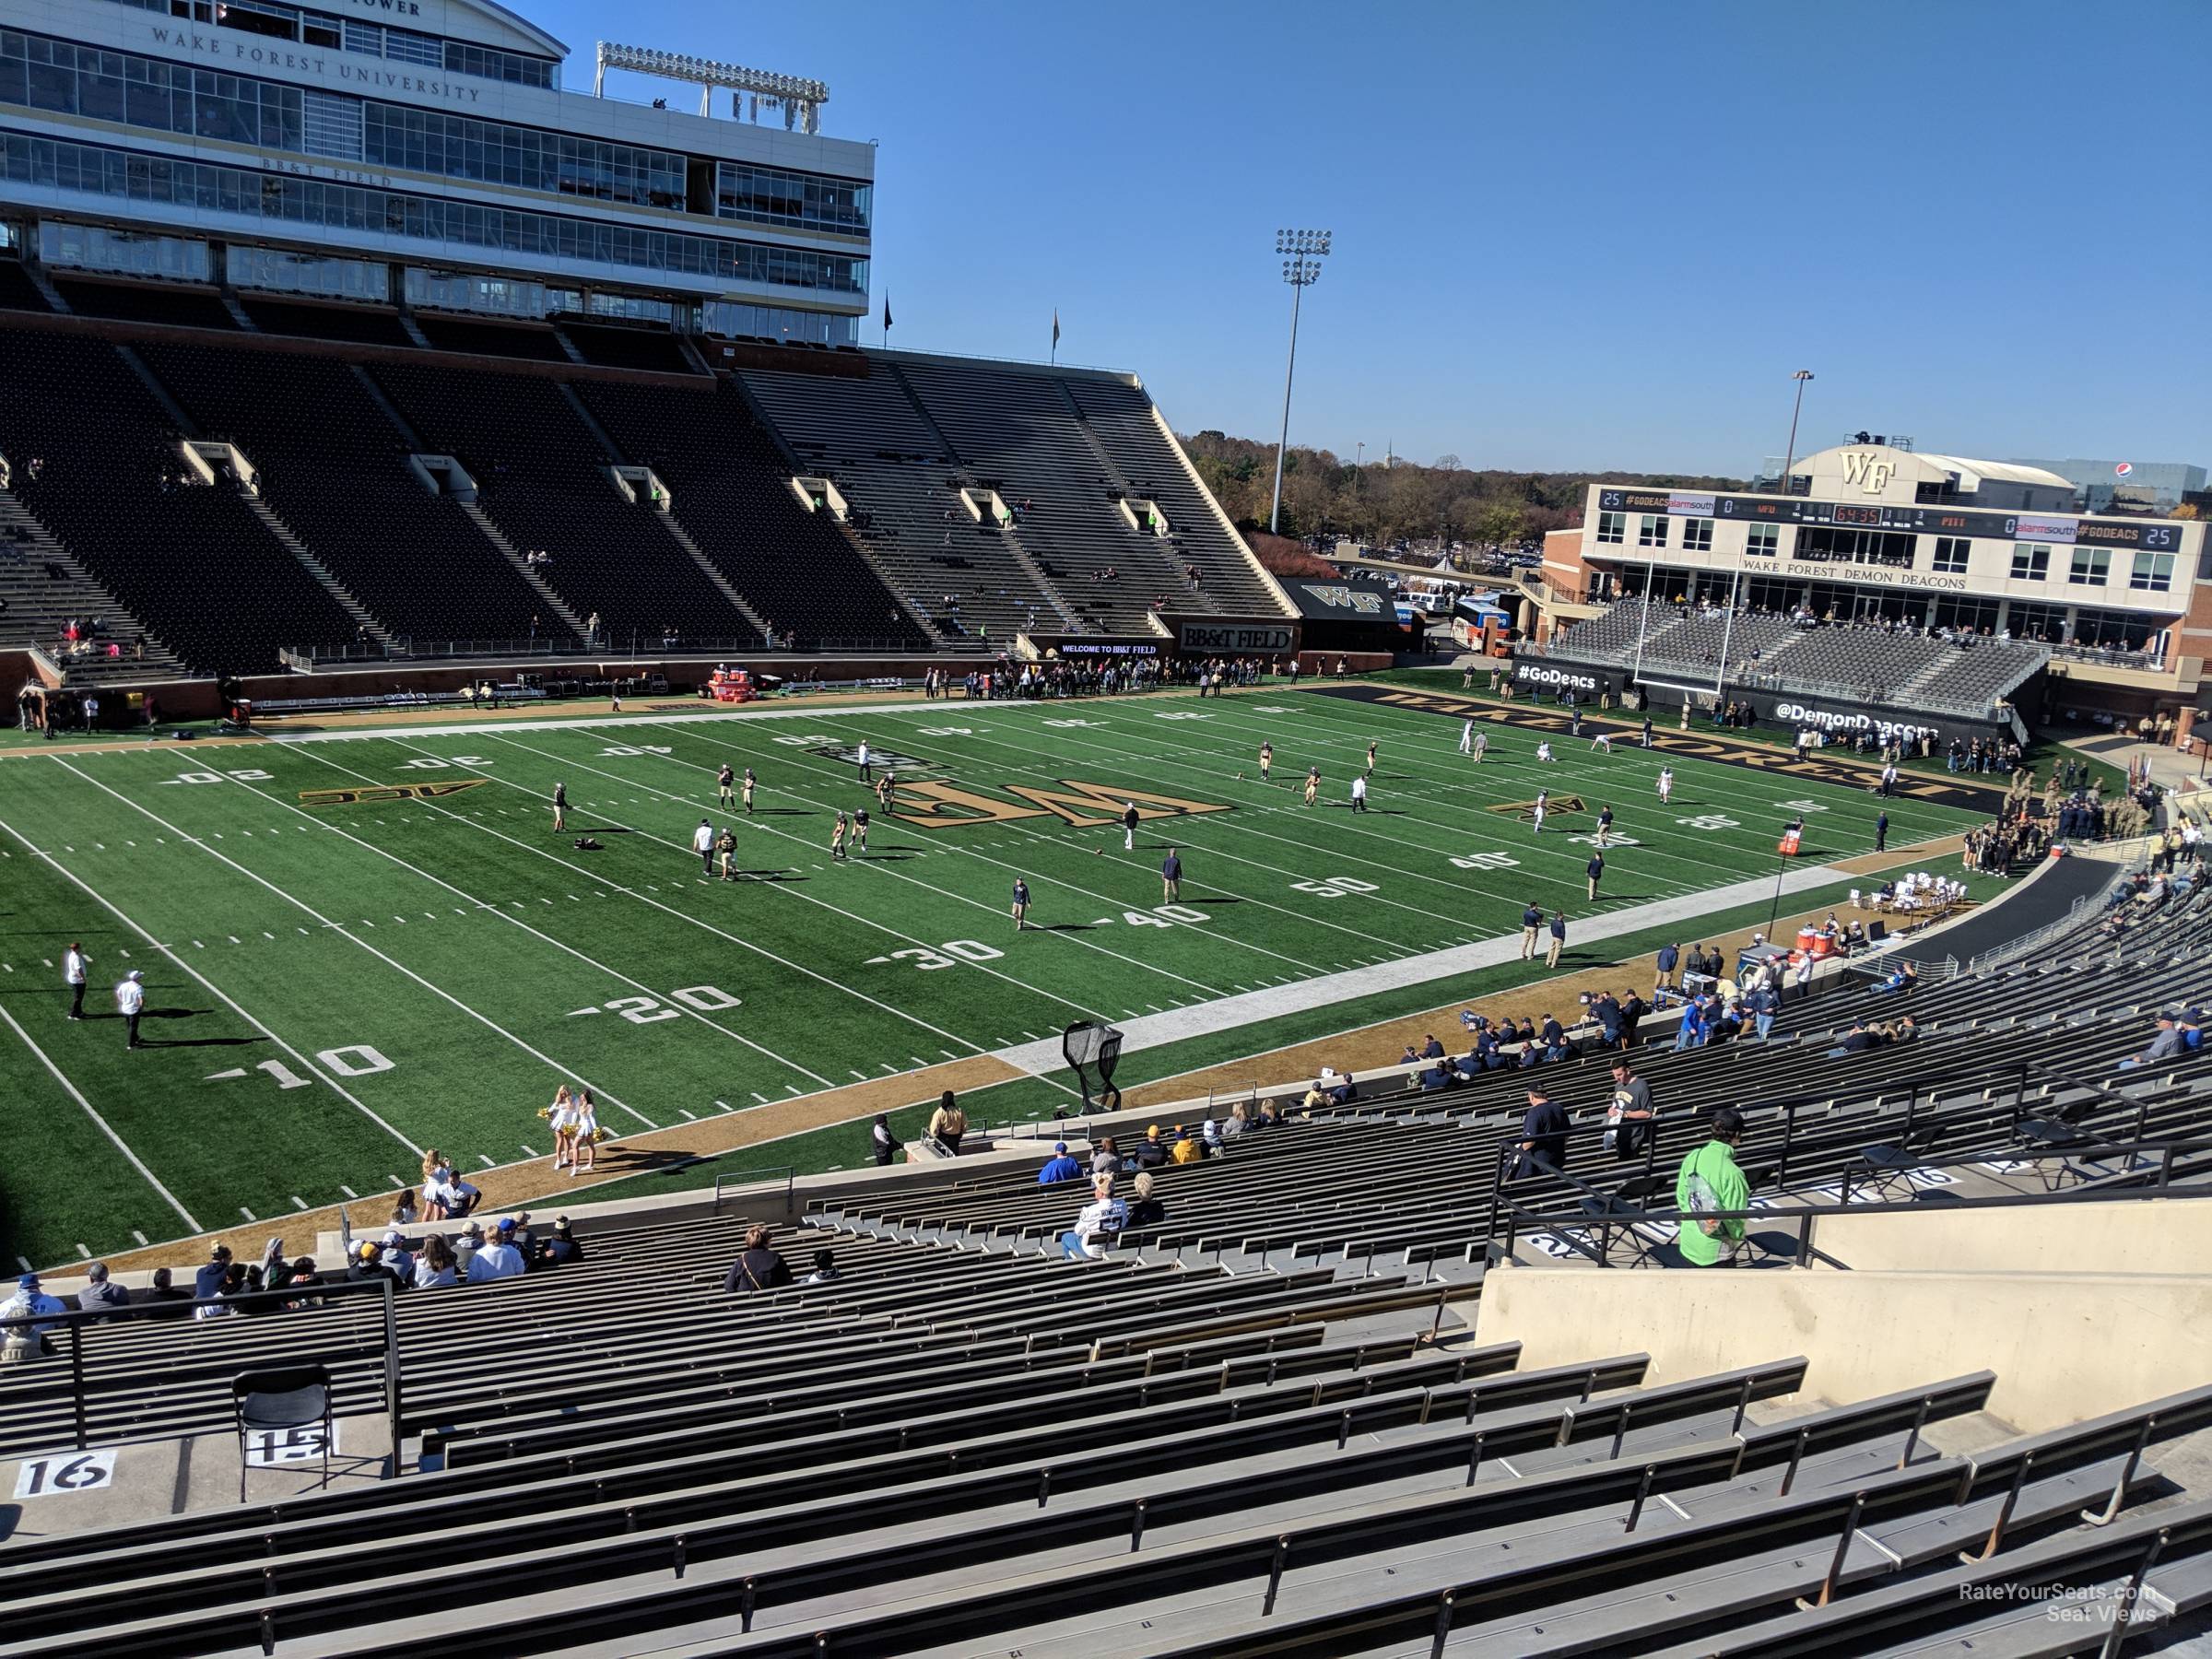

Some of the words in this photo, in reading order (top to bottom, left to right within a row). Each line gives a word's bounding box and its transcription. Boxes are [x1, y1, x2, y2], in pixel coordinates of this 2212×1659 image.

[353, 0, 420, 16] OWER
[152, 28, 220, 53] WAKE
[236, 45, 325, 74] FOREST
[339, 65, 479, 102] UNIVERSITY
[263, 159, 314, 176] BB&T
[334, 170, 392, 187] FIELD
[1839, 452, 1896, 494] WF
[1605, 493, 1619, 506] 25
[1626, 495, 1669, 507] #GODEACS
[1668, 500, 1714, 510] alarmsouth
[1724, 500, 1733, 513] 0
[1941, 516, 1966, 527] PITT
[2005, 518, 2016, 534] 0
[2017, 524, 2077, 535] alarmsouth
[2077, 524, 2139, 540] #GODEACS
[2147, 529, 2171, 545] 25
[1744, 559, 1780, 571] WAKE
[1787, 564, 1837, 578] FOREST
[1844, 569, 1894, 583] DEMON
[1900, 573, 1966, 590] DEACONS
[1300, 584, 1383, 613] WF
[1184, 628, 1235, 647] BB&T
[1236, 630, 1291, 649] FIELD
[1133, 646, 1157, 654] FIELD
[1519, 665, 1596, 689] #GoDeacs
[1374, 693, 1588, 729] WAKE
[771, 735, 843, 746] 50
[603, 745, 673, 756] 40
[408, 756, 494, 769] 30
[1602, 730, 1981, 799] FOREST
[178, 770, 275, 784] 20
[881, 777, 1240, 829] WF
[1773, 800, 1830, 813] 10
[1675, 815, 1742, 830] 20
[1448, 853, 1522, 871] 40
[1289, 877, 1381, 899] 50
[1121, 904, 1212, 929] 40
[889, 939, 1006, 971] 30
[604, 985, 743, 1025] 20
[256, 1044, 397, 1090] 10
[257, 1428, 329, 1464] 15
[29, 1455, 108, 1494] 16
